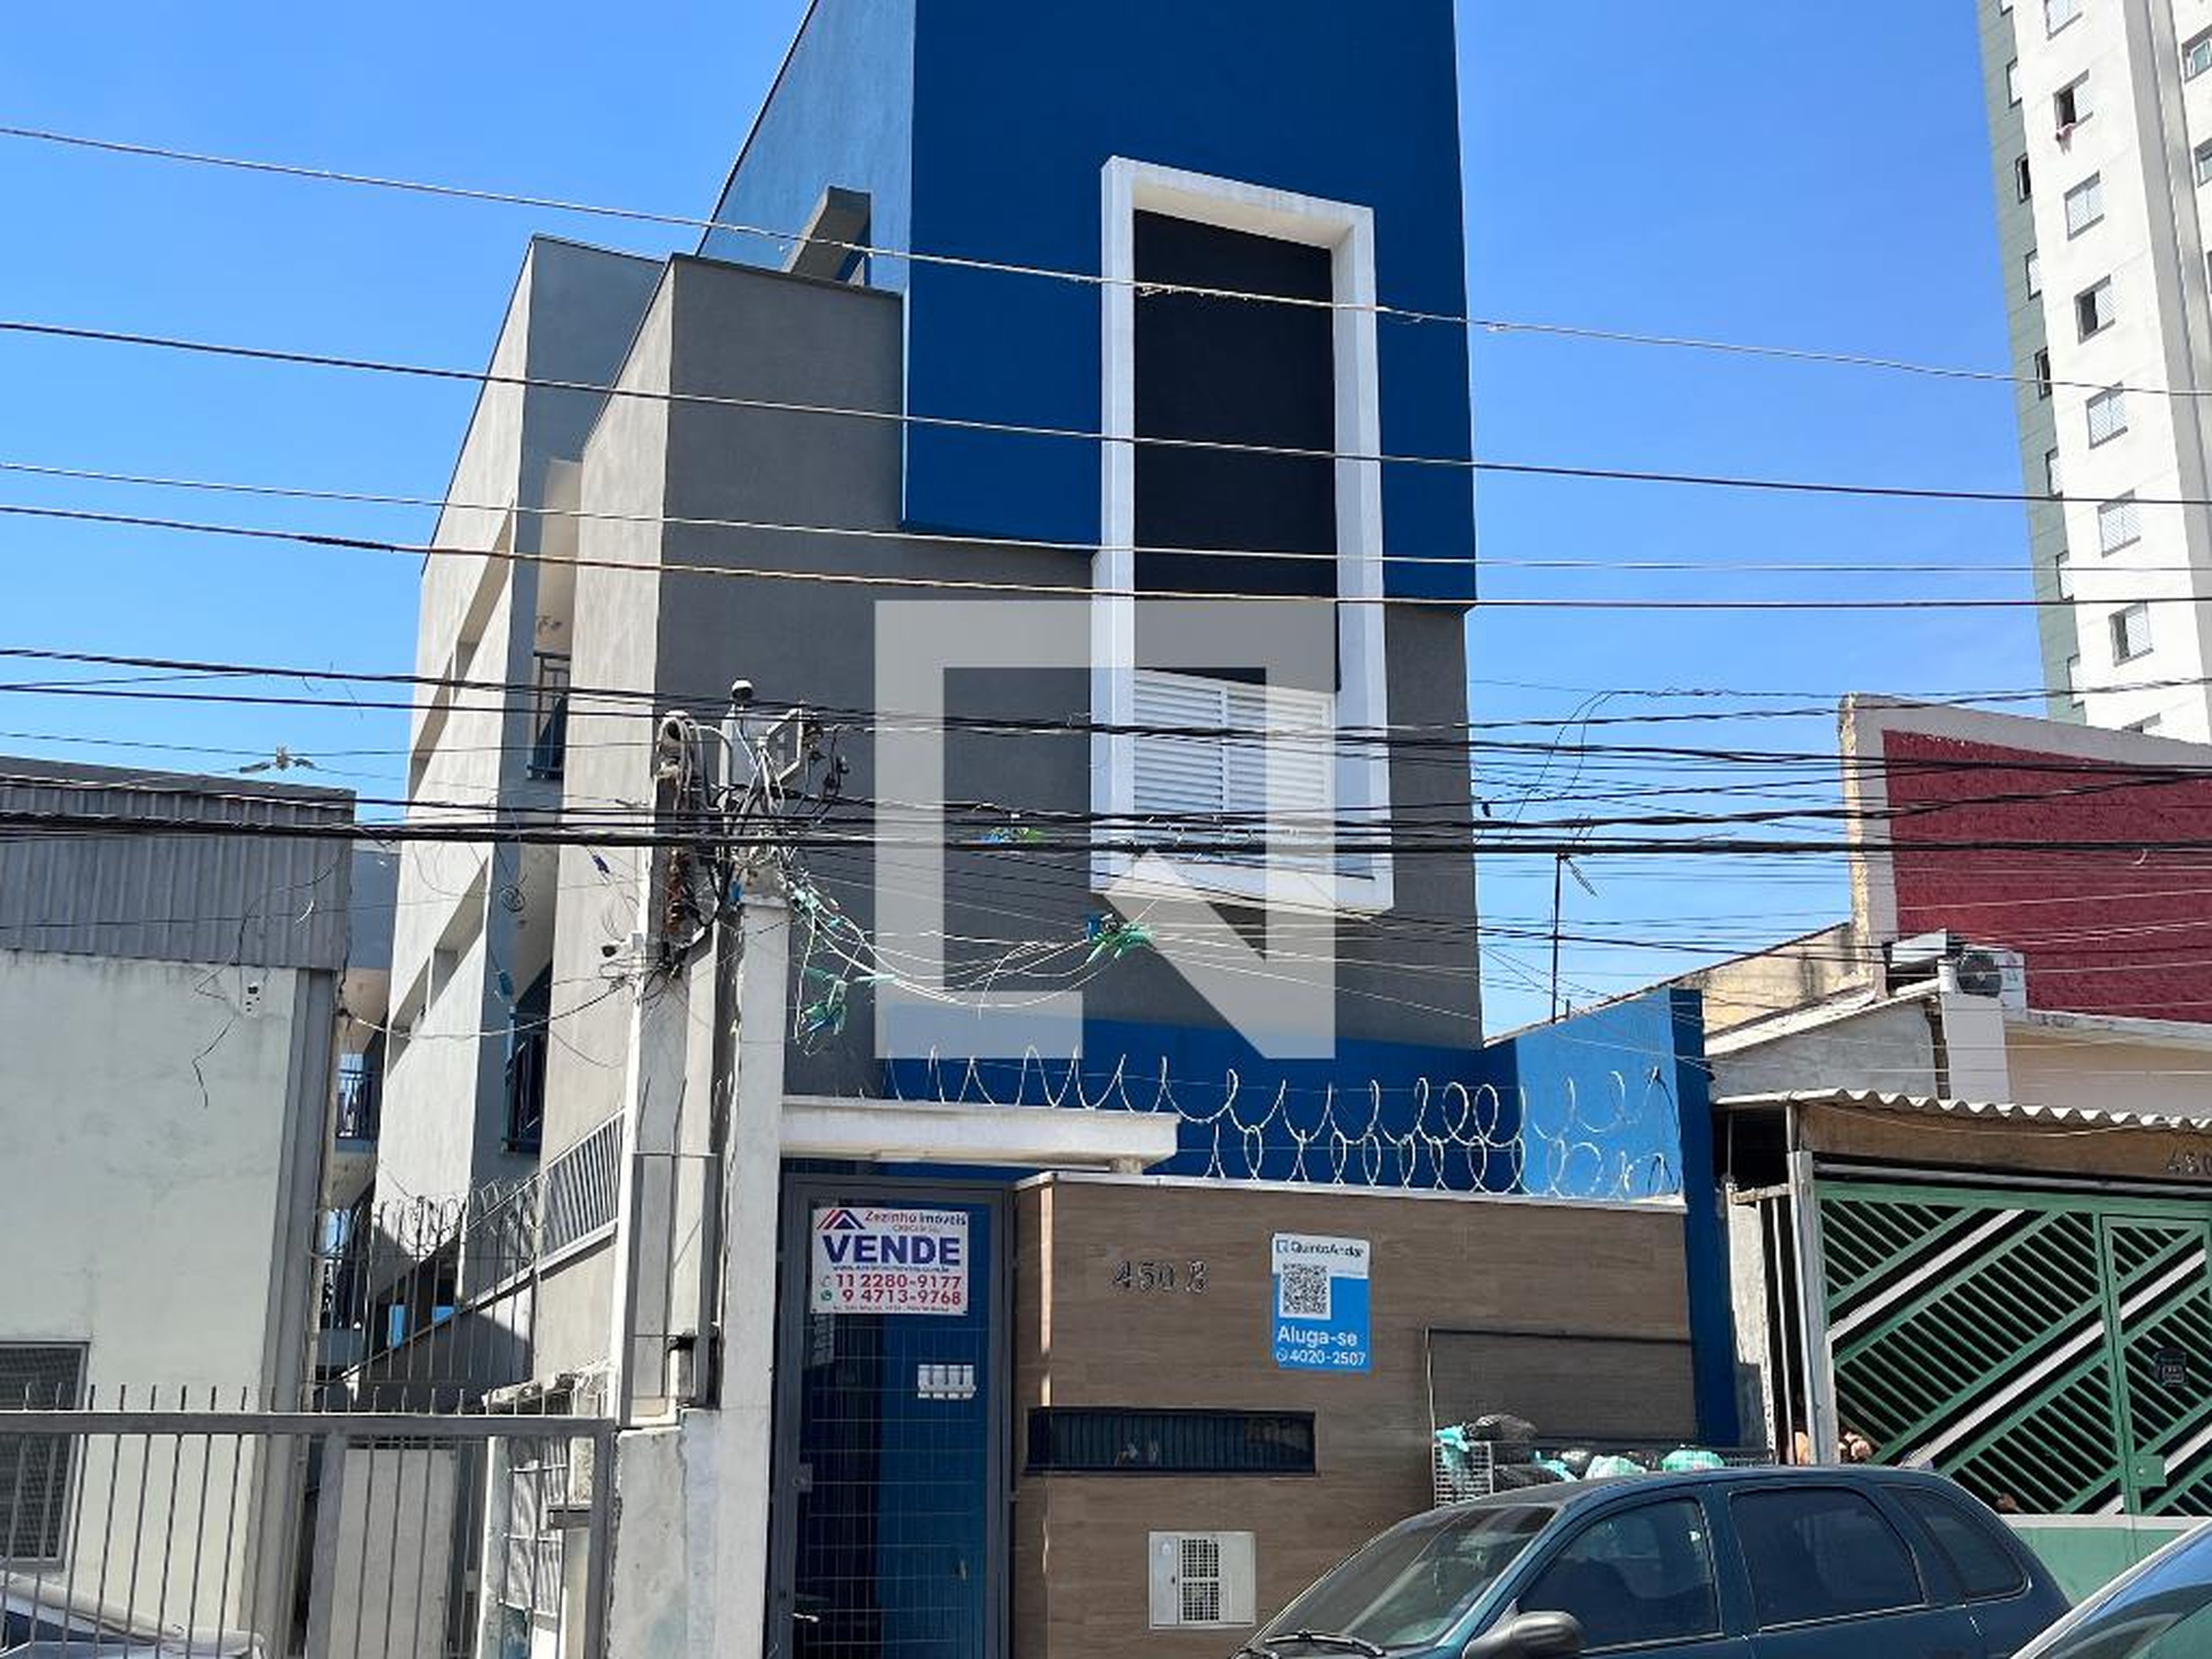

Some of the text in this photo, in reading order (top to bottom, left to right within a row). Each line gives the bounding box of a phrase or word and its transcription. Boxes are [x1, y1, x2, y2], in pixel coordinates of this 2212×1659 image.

[865, 1210, 917, 1223] Zezinho
[823, 1235, 960, 1266] VENDE
[836, 1274, 961, 1289] 11 2280-9177
[842, 1289, 961, 1305] 9 4713-9768
[1277, 1325, 1358, 1348] Aluga-se
[1289, 1349, 1366, 1366] 4020-2507
